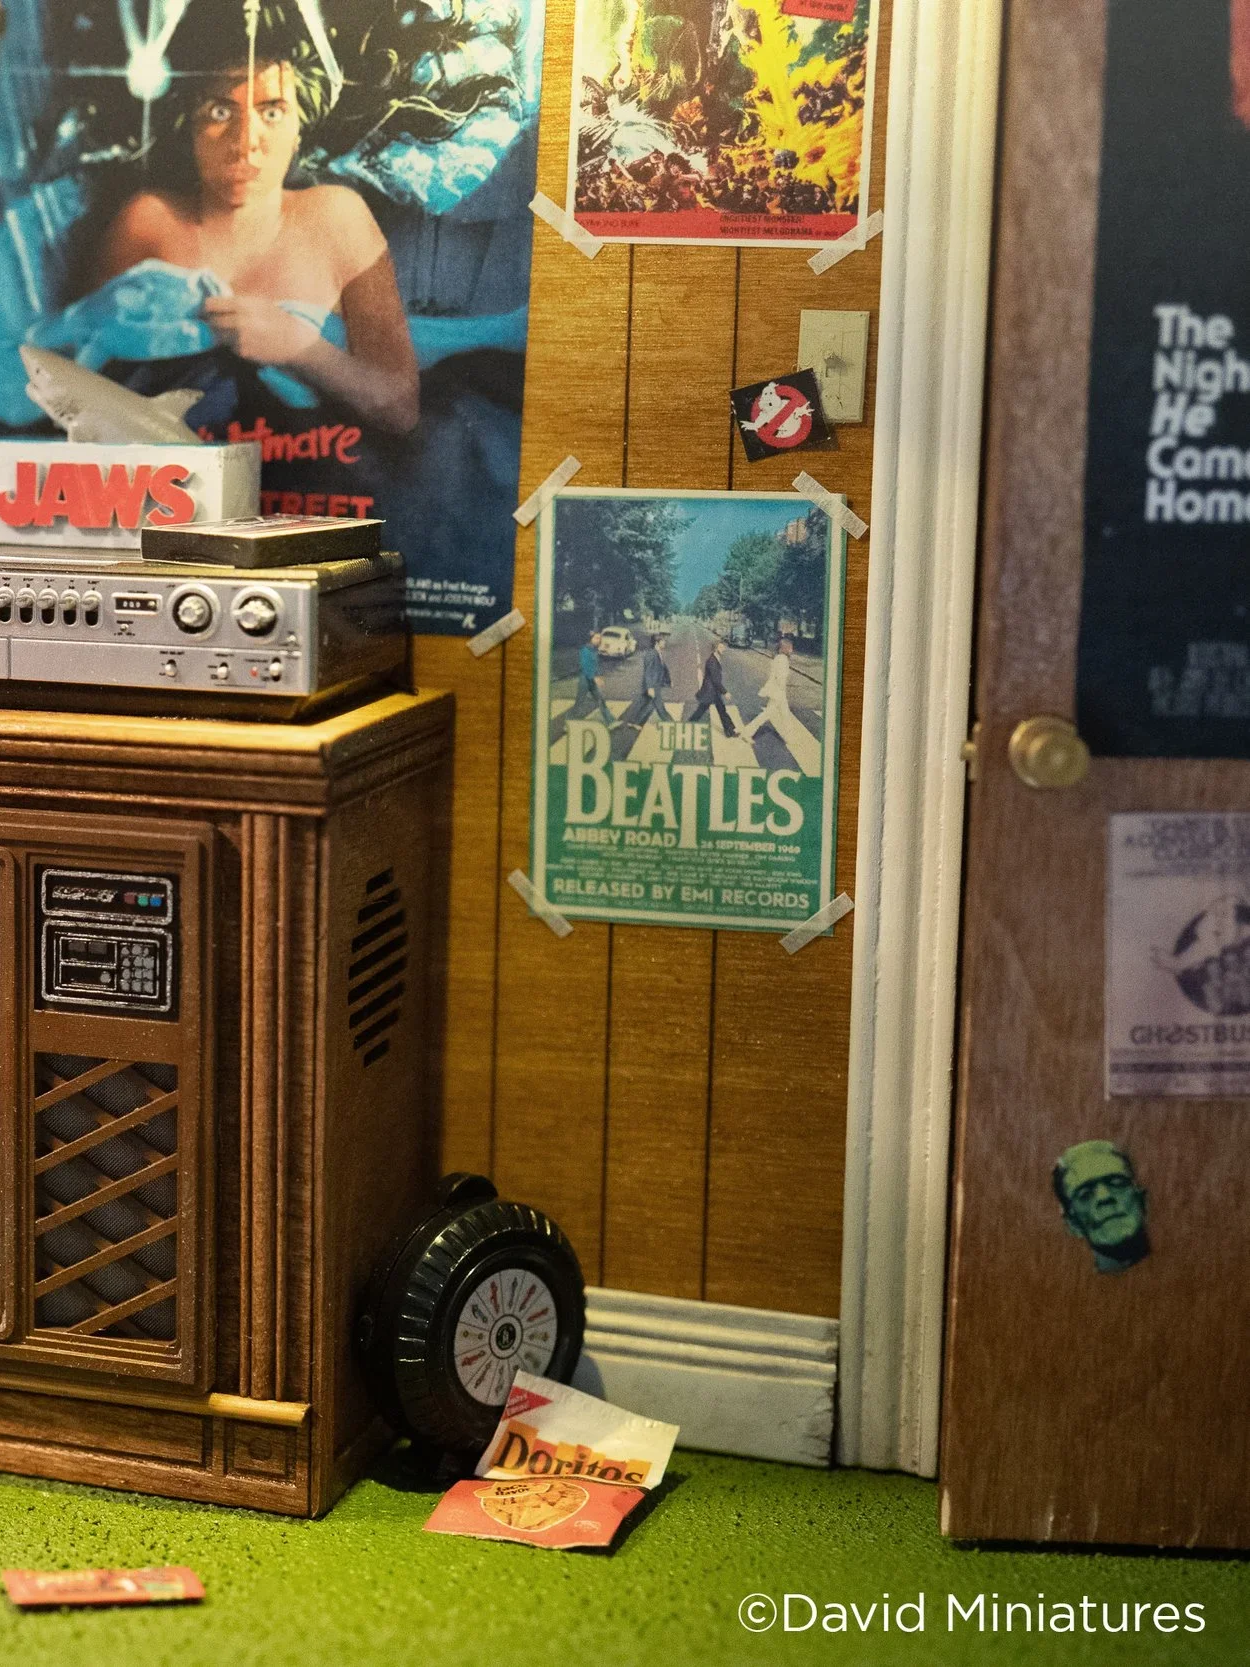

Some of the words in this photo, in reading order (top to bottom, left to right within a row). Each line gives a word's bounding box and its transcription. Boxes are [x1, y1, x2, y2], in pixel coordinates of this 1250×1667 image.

[1153, 303, 1234, 349] The
[1149, 391, 1217, 438] He
[657, 721, 710, 751] THE
[564, 719, 805, 850] BEATLES
[562, 827, 621, 844] ABBEY
[623, 830, 677, 848] ROAD
[552, 877, 645, 899] RELEASED
[651, 884, 675, 900] BY
[681, 885, 714, 904] EMI
[721, 888, 810, 909] RECORDS
[493, 1431, 647, 1486] Doritos
